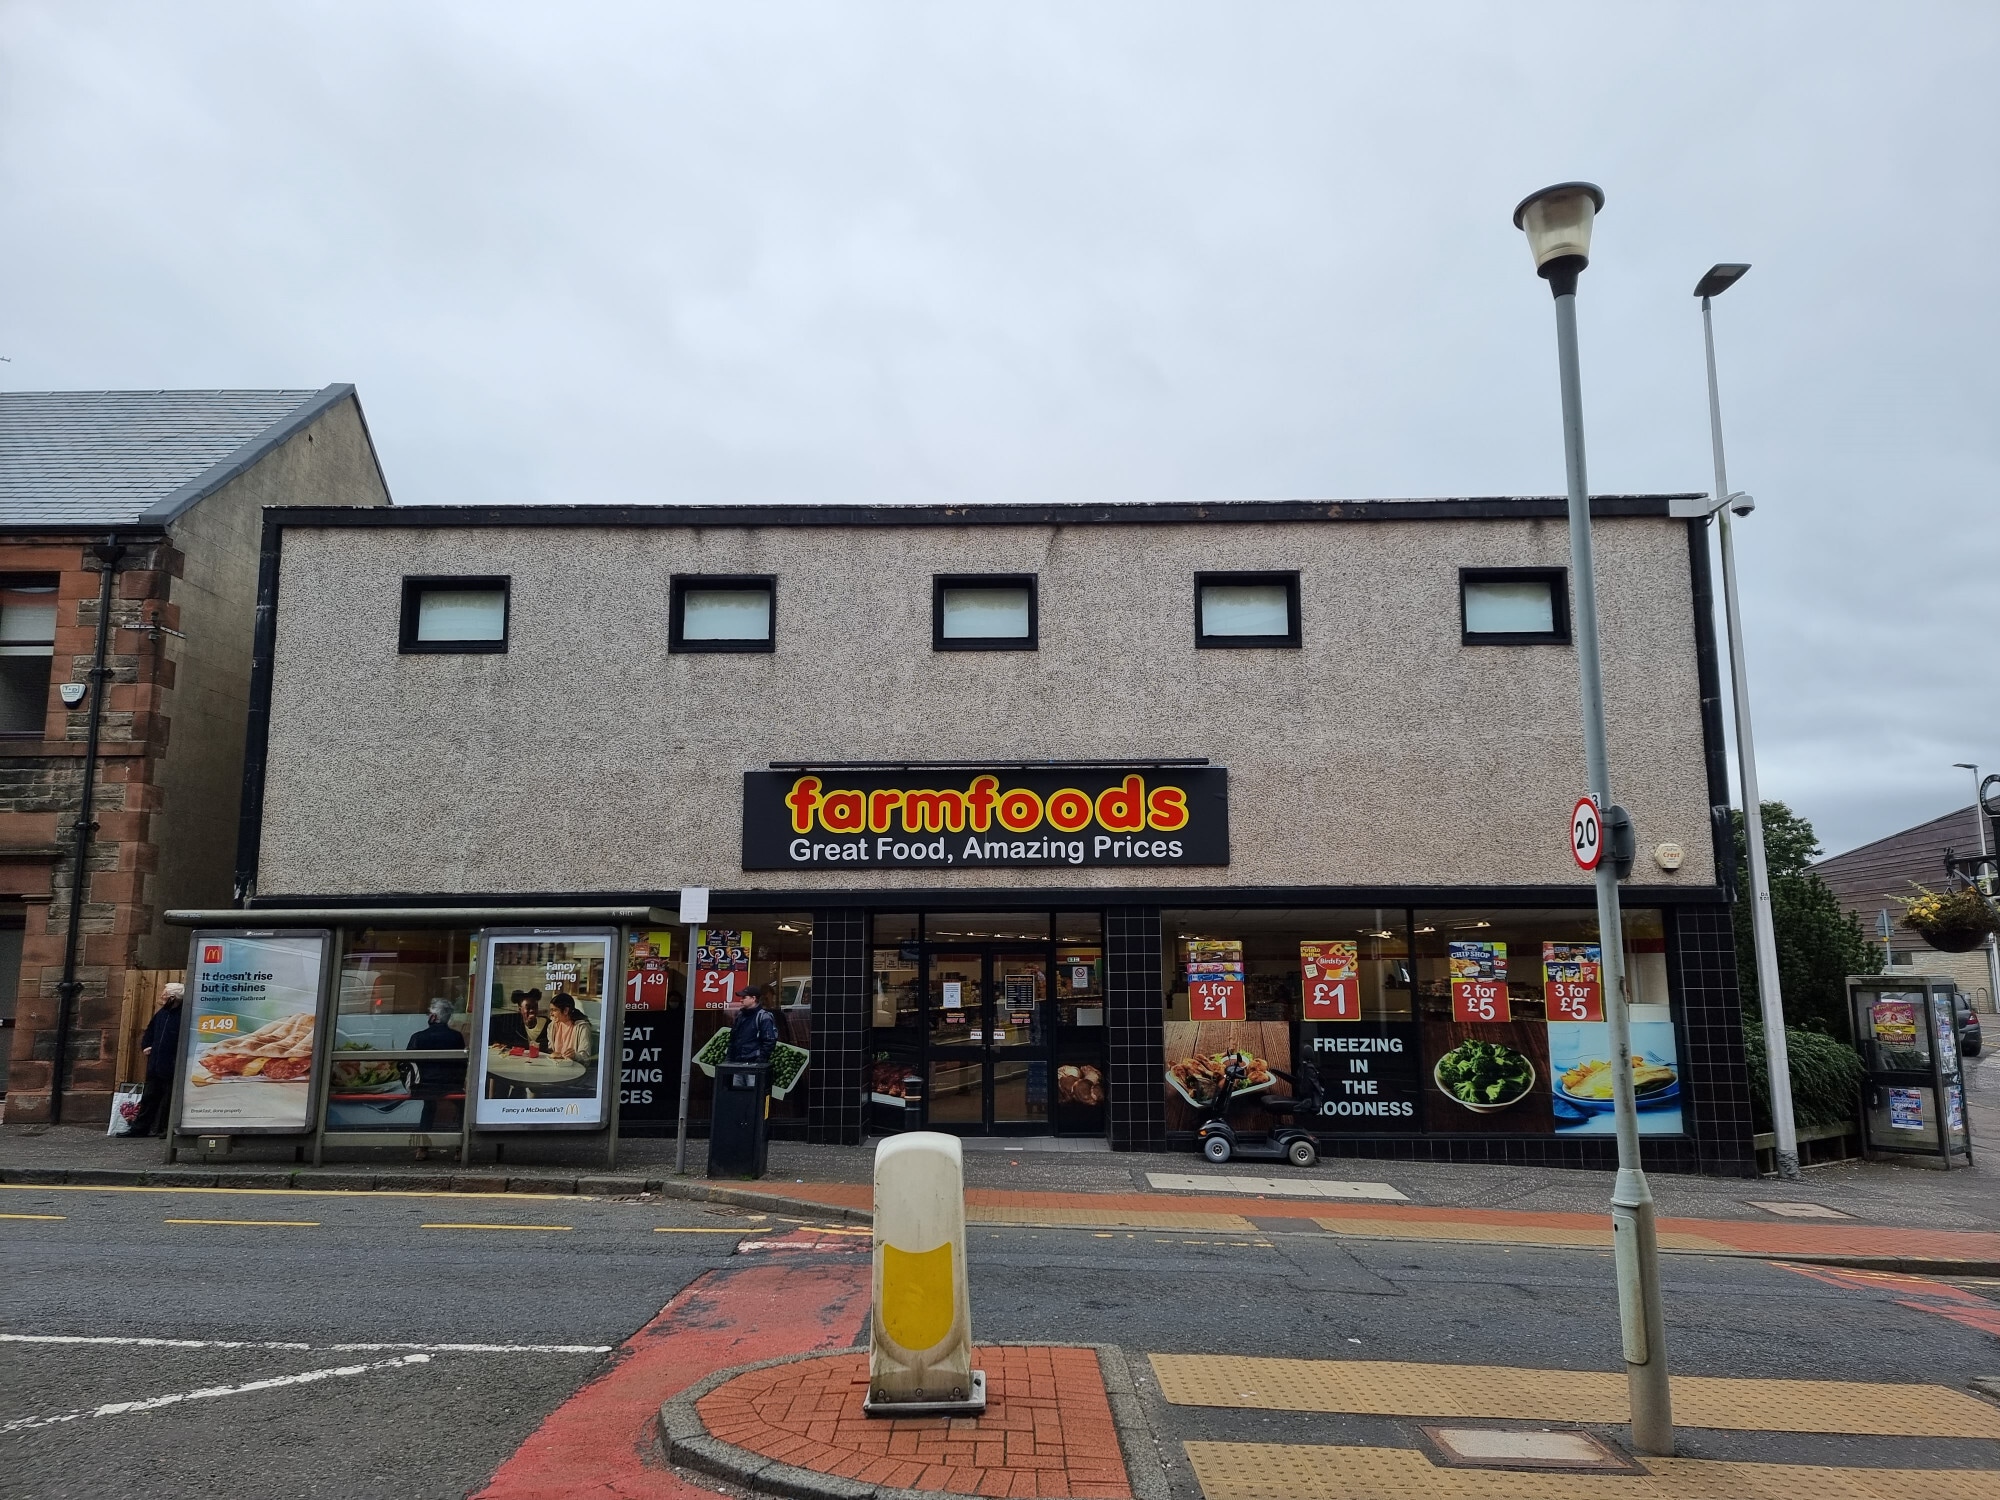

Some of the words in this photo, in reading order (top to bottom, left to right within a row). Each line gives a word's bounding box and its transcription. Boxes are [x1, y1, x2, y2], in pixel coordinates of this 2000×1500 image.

[785, 774, 1190, 834] farmfoods
[1575, 817, 1596, 849] 20
[789, 838, 869, 861] Great
[876, 837, 954, 864] Food,
[962, 836, 1085, 864] Amazing
[1094, 834, 1184, 859] Prices
[546, 961, 575, 972] Fancy
[202, 972, 210, 981] It
[212, 972, 251, 981] doesn't
[253, 971, 273, 980] rise
[545, 971, 577, 983] telling
[201, 984, 219, 993] but
[221, 983, 230, 992] it
[231, 983, 266, 992] shines
[545, 981, 563, 991] all?
[703, 971, 735, 1003] £1
[1198, 984, 1208, 995] 4
[1211, 983, 1233, 996] for
[1461, 985, 1472, 998] 2
[1474, 984, 1497, 998] for
[1555, 984, 1565, 997] 3
[1568, 983, 1590, 997] for
[625, 1001, 649, 1010] each
[705, 1001, 730, 1009] each
[1313, 983, 1346, 1015] £1
[1203, 996, 1228, 1018] £1
[1467, 998, 1495, 1020] £5
[1560, 998, 1587, 1020] £5
[201, 1018, 234, 1030] £1.49
[623, 1027, 654, 1041] EAT
[1313, 1038, 1403, 1052] FREEZING
[638, 1048, 662, 1062] AT
[1350, 1059, 1368, 1073] IN
[620, 1069, 663, 1083] ZING
[1342, 1080, 1378, 1095] THE
[619, 1090, 653, 1104] CES
